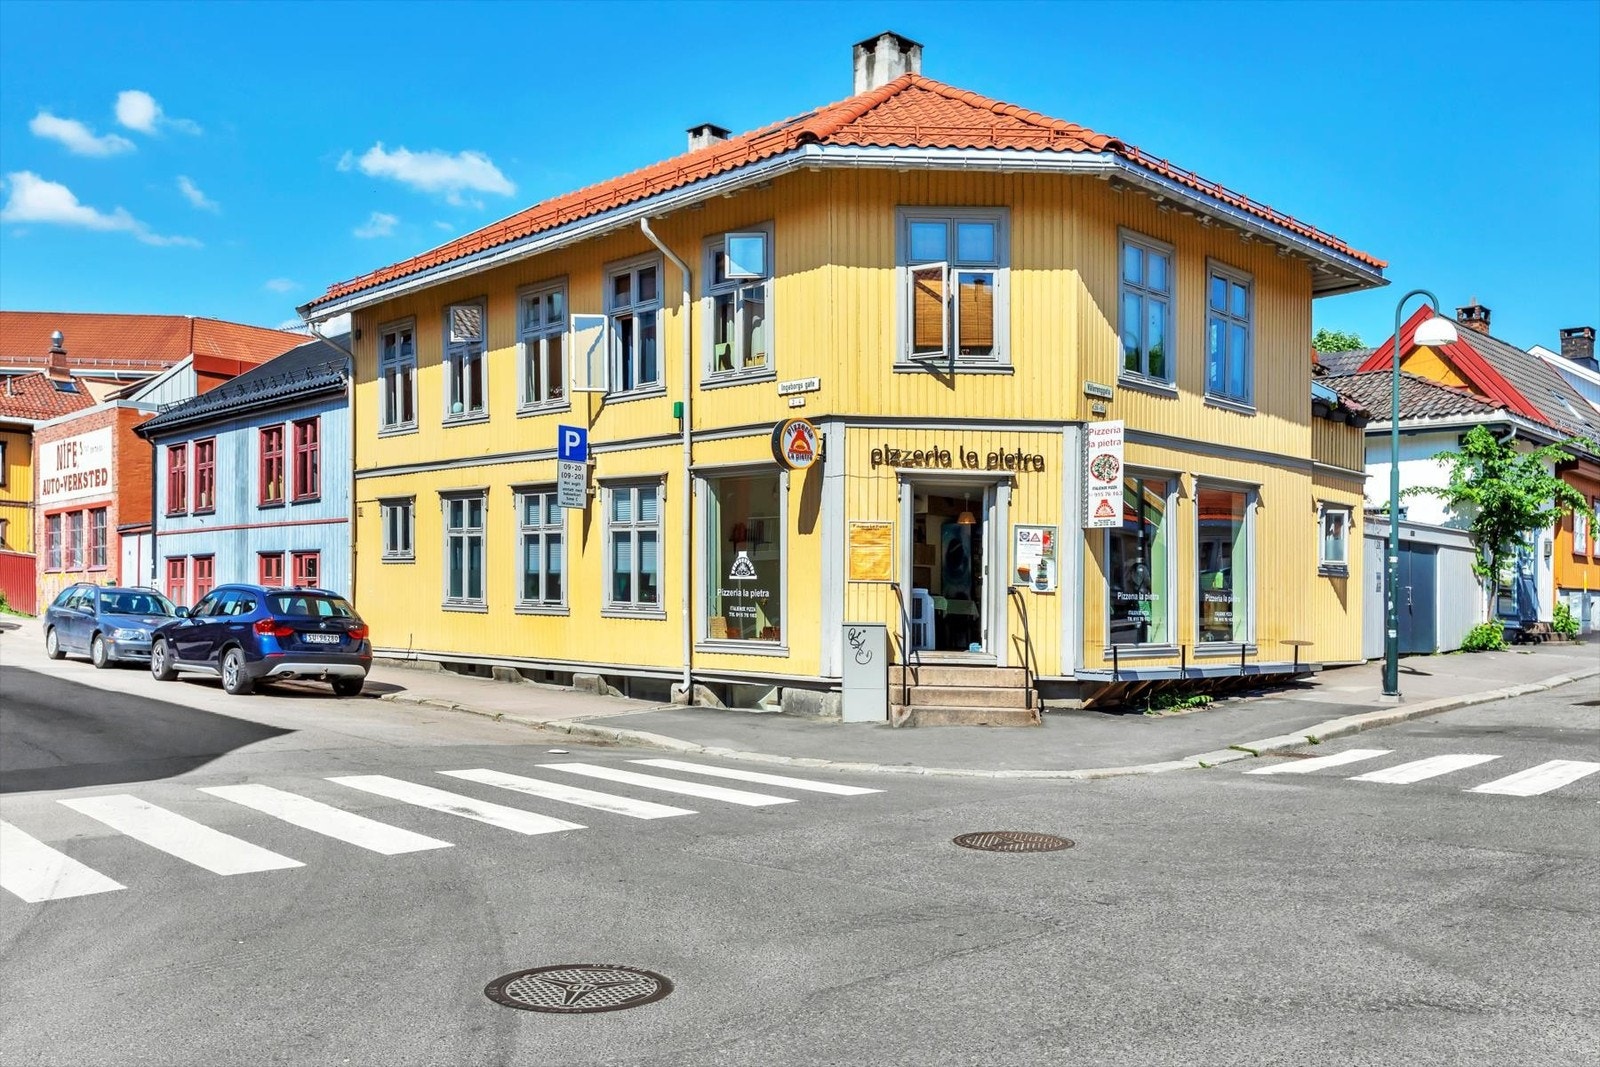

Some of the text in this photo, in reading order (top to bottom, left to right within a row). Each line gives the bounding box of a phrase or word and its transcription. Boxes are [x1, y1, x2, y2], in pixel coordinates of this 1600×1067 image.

[781, 380, 815, 393] Ingeborgs gate
[787, 423, 814, 439] Pizzeria
[1088, 427, 1121, 436] Pizzeria
[565, 430, 581, 457] P
[1098, 439, 1122, 449] pietra
[796, 453, 813, 462] pietra
[871, 443, 1045, 473] pizzeria la pietra
[42, 467, 108, 496] AUTO-VERKSTED
[717, 588, 770, 599] Pizzeria la pietra
